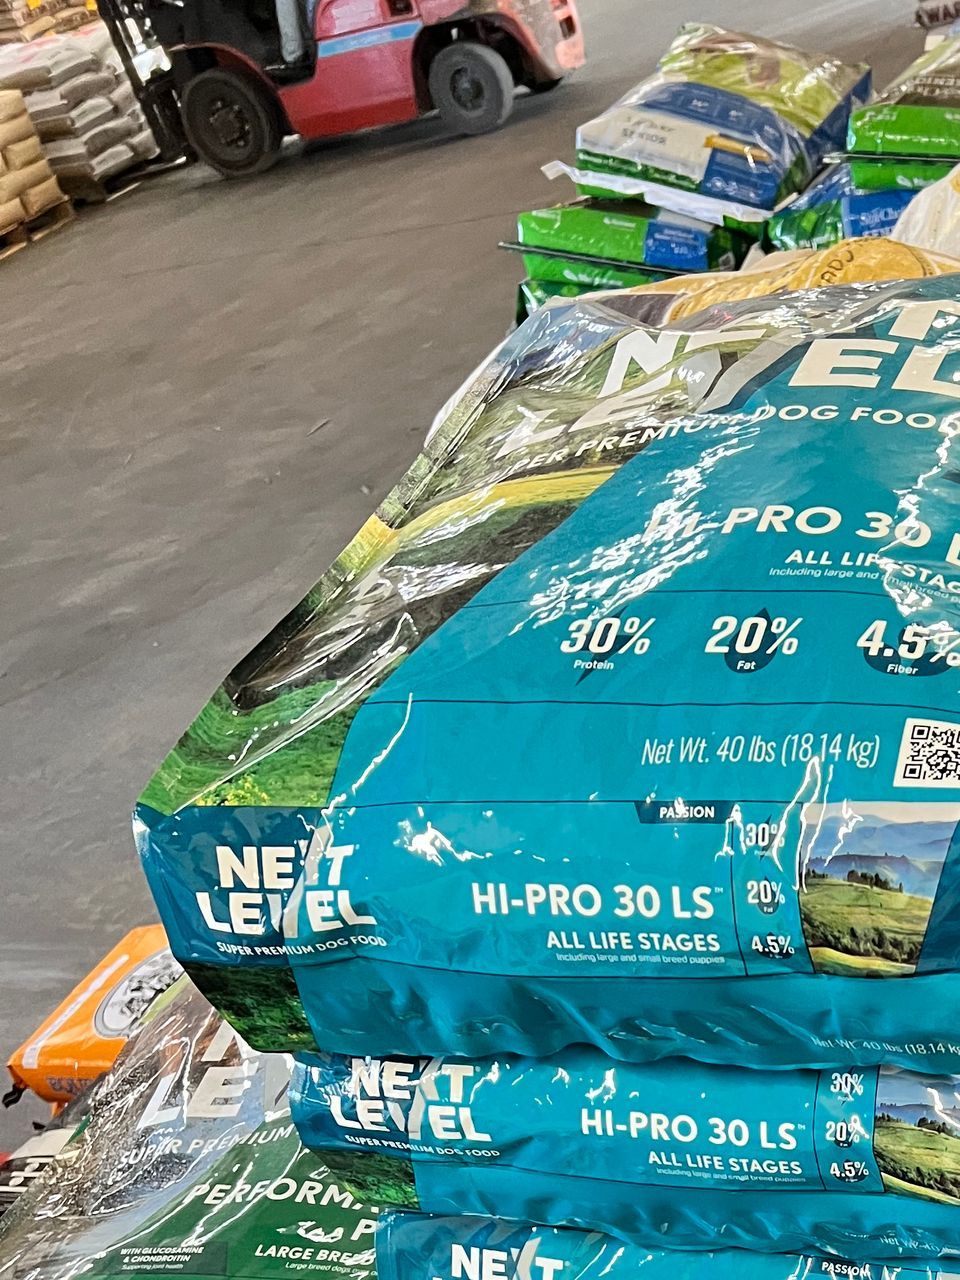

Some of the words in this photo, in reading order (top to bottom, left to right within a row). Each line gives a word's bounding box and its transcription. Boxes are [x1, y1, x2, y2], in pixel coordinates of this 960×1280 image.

[752, 404, 840, 422] DOG
[855, 511, 932, 548] 30
[784, 549, 833, 567] ALL
[768, 567, 822, 579] Including
[824, 567, 852, 579] large
[856, 570, 879, 580] and
[560, 615, 657, 655] 30%
[704, 614, 804, 655] 20%
[573, 659, 615, 672] Protein
[736, 660, 756, 671] Fat
[886, 662, 919, 676] Fiber
[641, 738, 673, 766] Net
[678, 736, 709, 764] Wt.
[716, 735, 745, 764] 40
[750, 734, 777, 763] lbs
[781, 732, 842, 768] (18.14
[850, 734, 881, 768] kg)
[658, 805, 716, 820] PASSION
[745, 822, 786, 849] 30%
[214, 824, 355, 890] NEXT
[471, 881, 603, 917] HI-PRO
[612, 884, 662, 919] 30
[746, 880, 786, 906] 20%
[195, 889, 378, 939] LEVEL
[216, 941, 253, 957] SUPER
[255, 943, 315, 957] PREMIUM
[316, 938, 349, 952] DOG
[350, 934, 388, 948] FOOD
[547, 930, 585, 949] ALL
[589, 931, 633, 952] LIFE
[638, 932, 721, 953] STAGES
[751, 935, 796, 956] 4.5%
[329, 1094, 493, 1143] LEVEL
[580, 1107, 698, 1143] HI-PRO
[708, 1116, 749, 1147] 30
[648, 1150, 682, 1168] ALL
[686, 1153, 724, 1171] LIFE
[728, 1157, 803, 1175] STAGES
[829, 1161, 870, 1178] 4.5%
[185, 1178, 380, 1211] PERFORM
[120, 1246, 142, 1255] WITH
[143, 1245, 204, 1256] GLUCOSAMINE
[130, 1254, 190, 1263] CHONDROITIN
[254, 1243, 313, 1260] LARGE
[821, 1260, 869, 1277] PASSION
